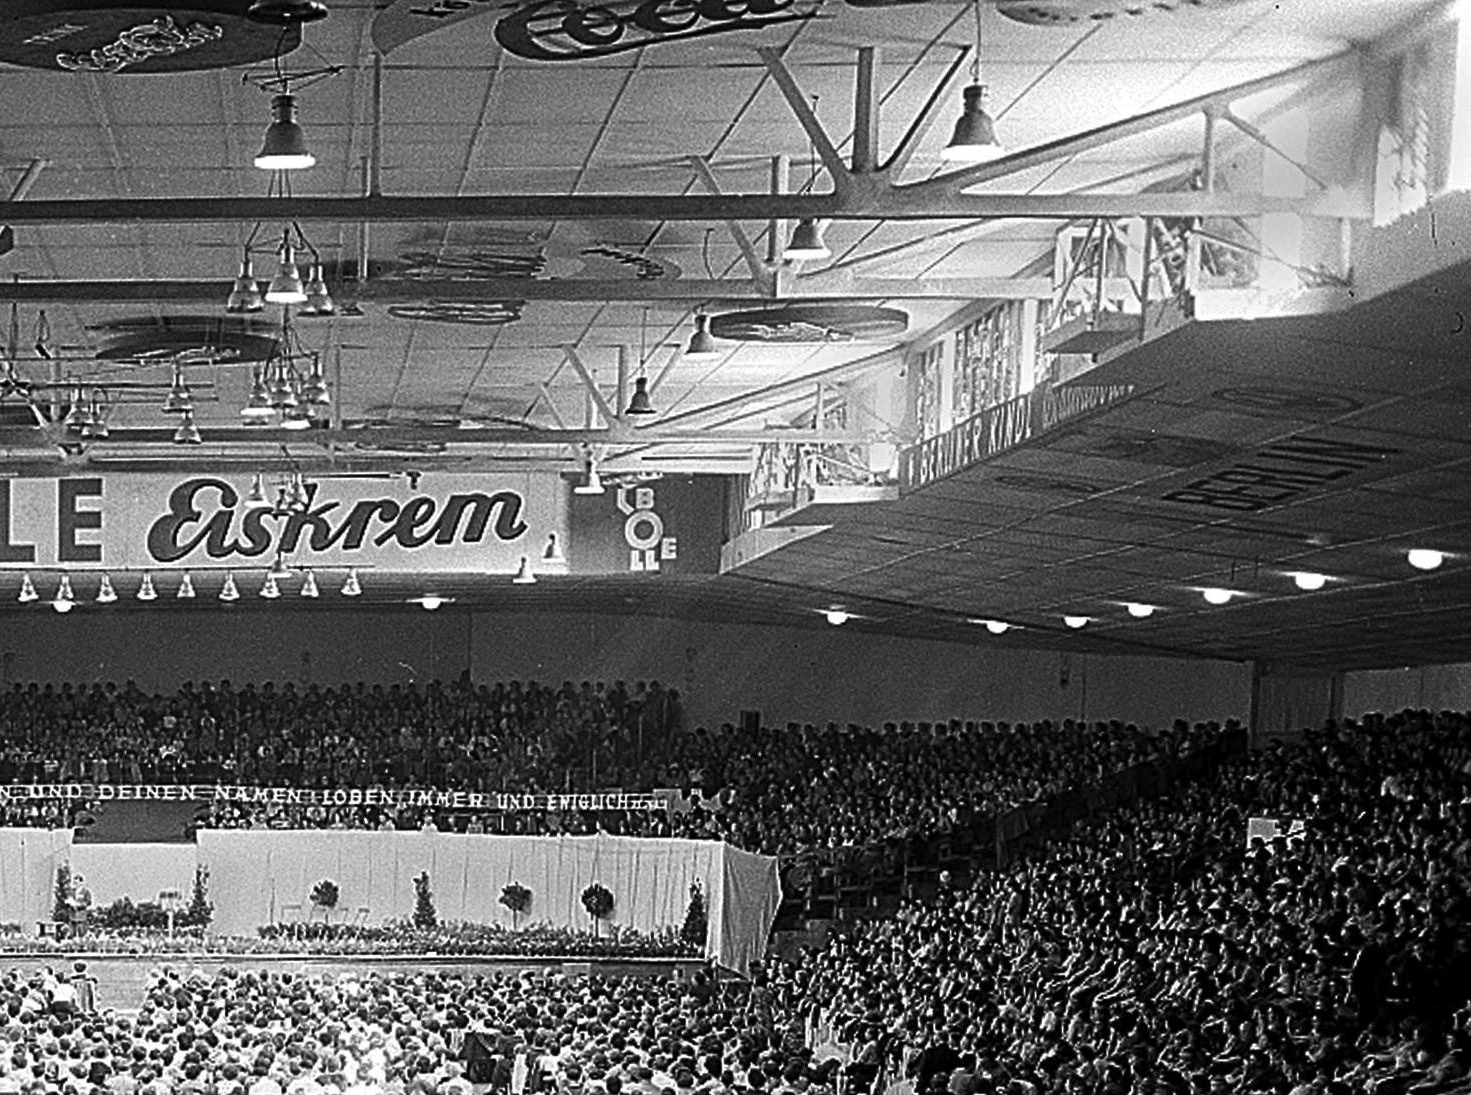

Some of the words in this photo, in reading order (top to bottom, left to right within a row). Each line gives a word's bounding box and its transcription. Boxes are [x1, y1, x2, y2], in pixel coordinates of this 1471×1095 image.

[1161, 434, 1403, 511] BERLIN
[147, 478, 528, 562] Eiskrem
[29, 784, 81, 799] UND
[98, 785, 196, 800] DEINEN
[215, 786, 302, 802] NAMEN
[322, 789, 394, 804] LOBEN
[408, 789, 483, 808] IMMER
[497, 793, 534, 809] UND
[547, 794, 631, 810] EWIGLICH
